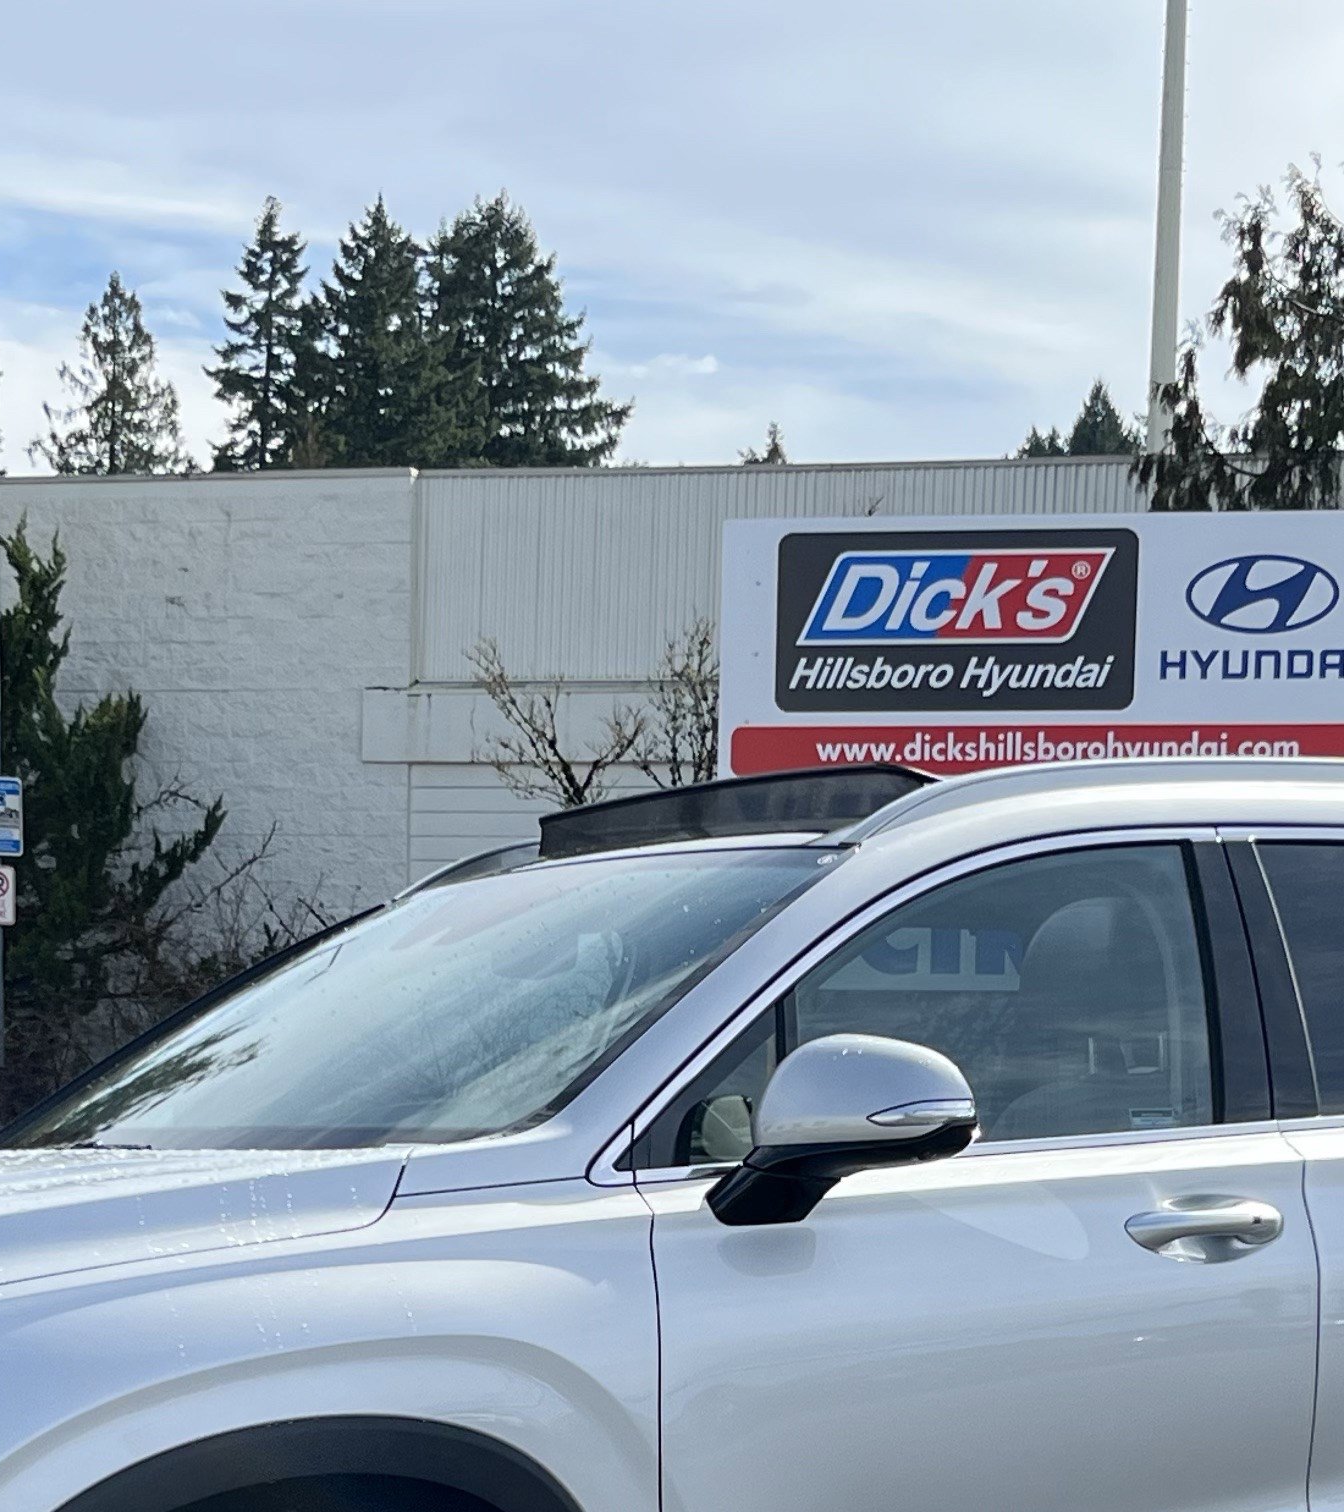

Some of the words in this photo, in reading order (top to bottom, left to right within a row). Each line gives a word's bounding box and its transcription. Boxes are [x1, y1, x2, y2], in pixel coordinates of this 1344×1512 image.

[822, 560, 1075, 631] Dick's
[789, 658, 954, 690] Hillsboro
[960, 656, 1115, 698] Hyundai
